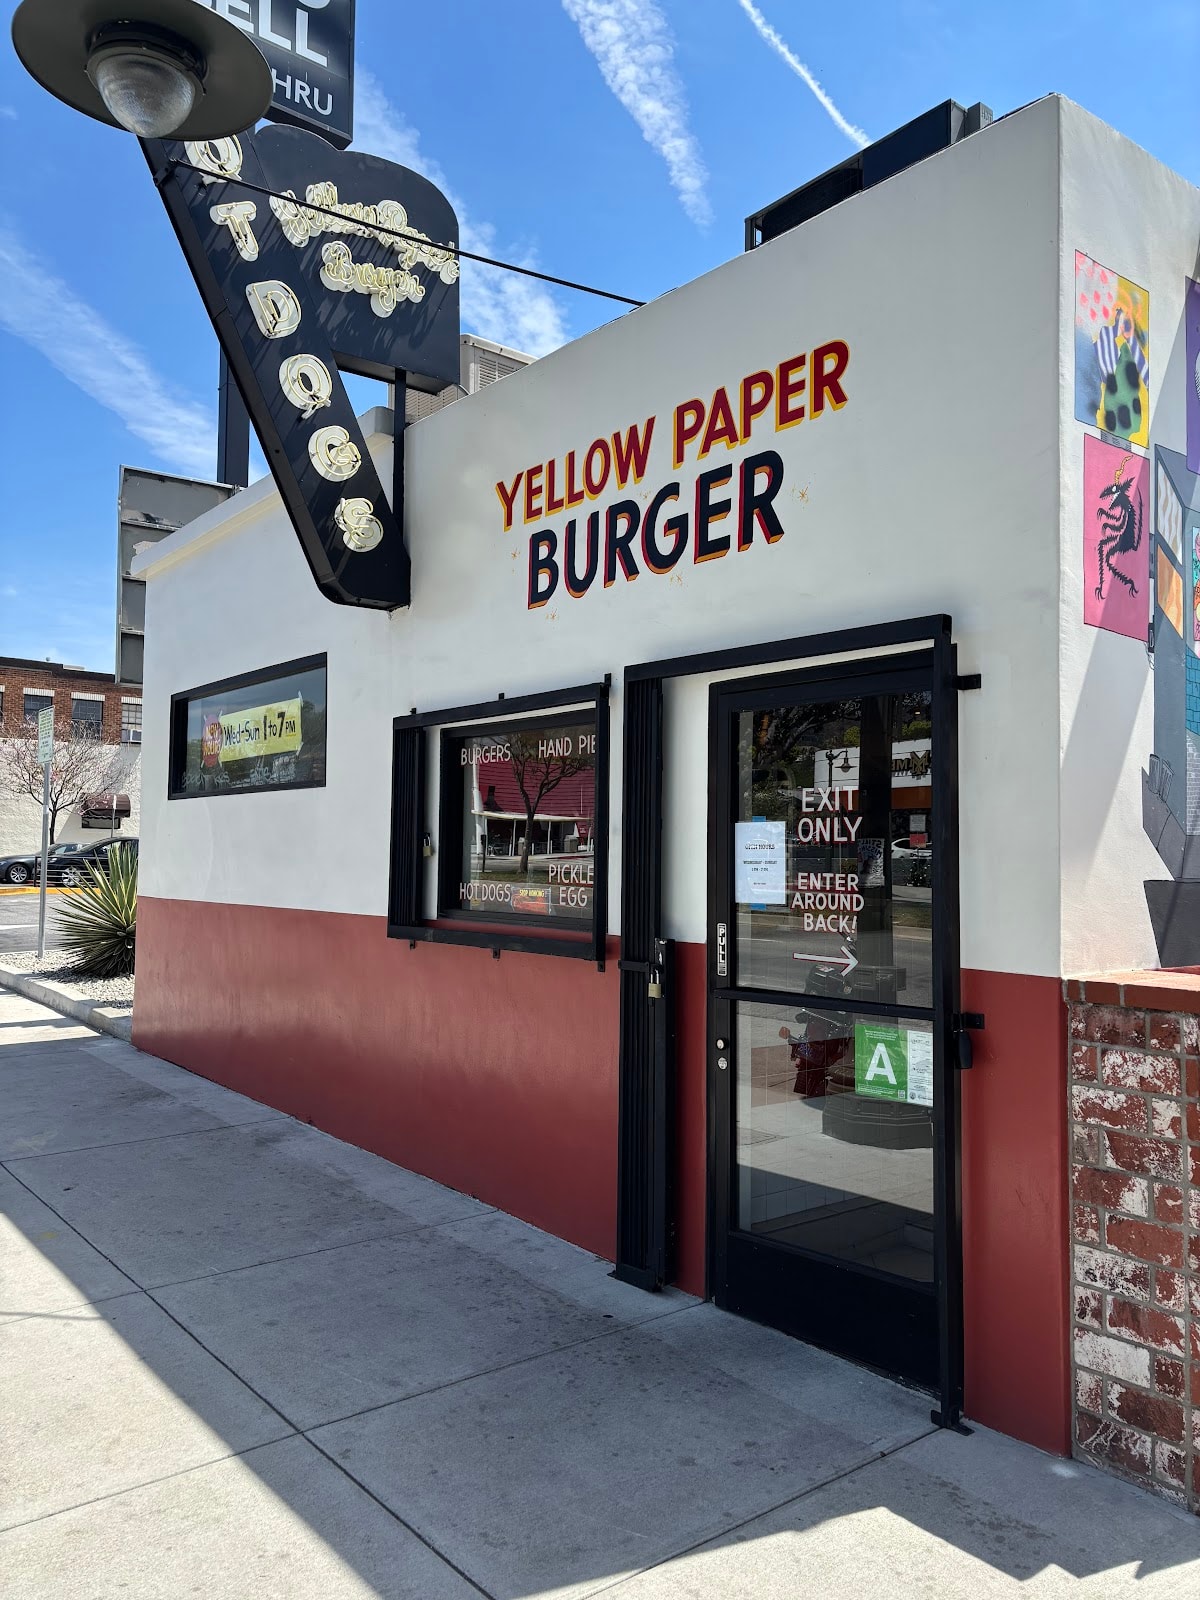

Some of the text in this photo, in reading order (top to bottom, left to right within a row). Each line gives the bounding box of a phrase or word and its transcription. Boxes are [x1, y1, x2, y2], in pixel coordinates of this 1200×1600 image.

[198, 0, 328, 68] ELL
[271, 67, 333, 116] HRU
[184, 135, 259, 262] OT
[246, 280, 384, 552] DOGS
[495, 339, 849, 532] YELLOW PAPER
[528, 450, 785, 610] BURGER
[223, 720, 260, 746] Wed-Sun
[268, 720, 277, 737] to
[277, 712, 286, 738] 7
[285, 720, 296, 733] PM
[461, 743, 511, 766] BURGERS
[538, 736, 572, 758] HAND
[801, 785, 860, 813] EXIT
[798, 816, 863, 843] ONLY
[548, 864, 594, 884] PICKLE
[797, 872, 859, 892] ENTER
[559, 886, 588, 907] EGG
[792, 893, 864, 911] AROUND
[803, 912, 857, 934] BACK!
[864, 1042, 898, 1085] A
